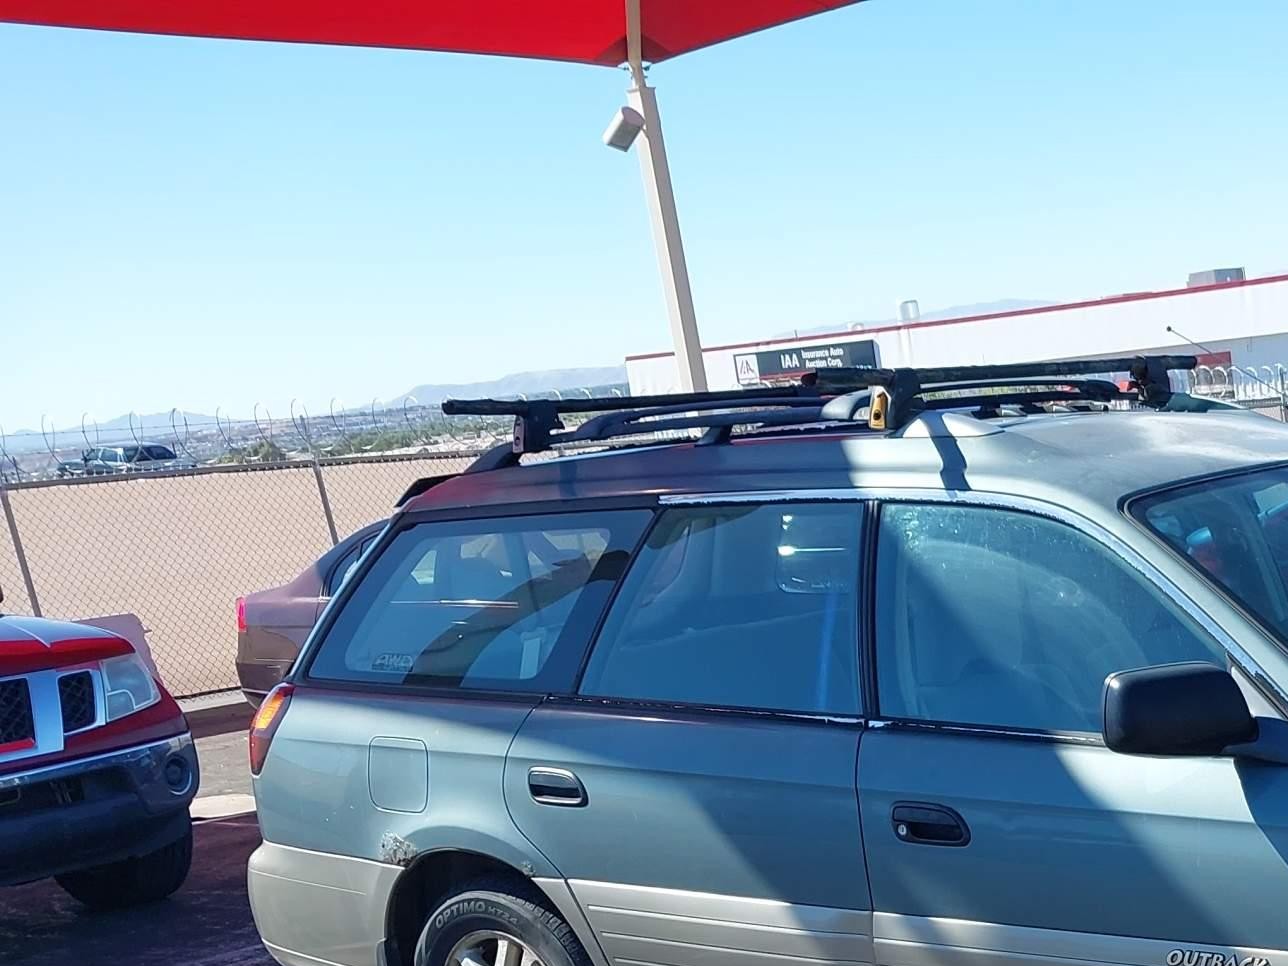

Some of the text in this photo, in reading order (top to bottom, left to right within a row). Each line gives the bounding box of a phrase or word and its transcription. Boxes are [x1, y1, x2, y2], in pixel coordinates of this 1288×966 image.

[801, 347, 844, 359] Insurance Auto
[780, 353, 800, 369] IAA
[805, 358, 828, 369] Auction
[435, 901, 486, 929] OPTIMO
